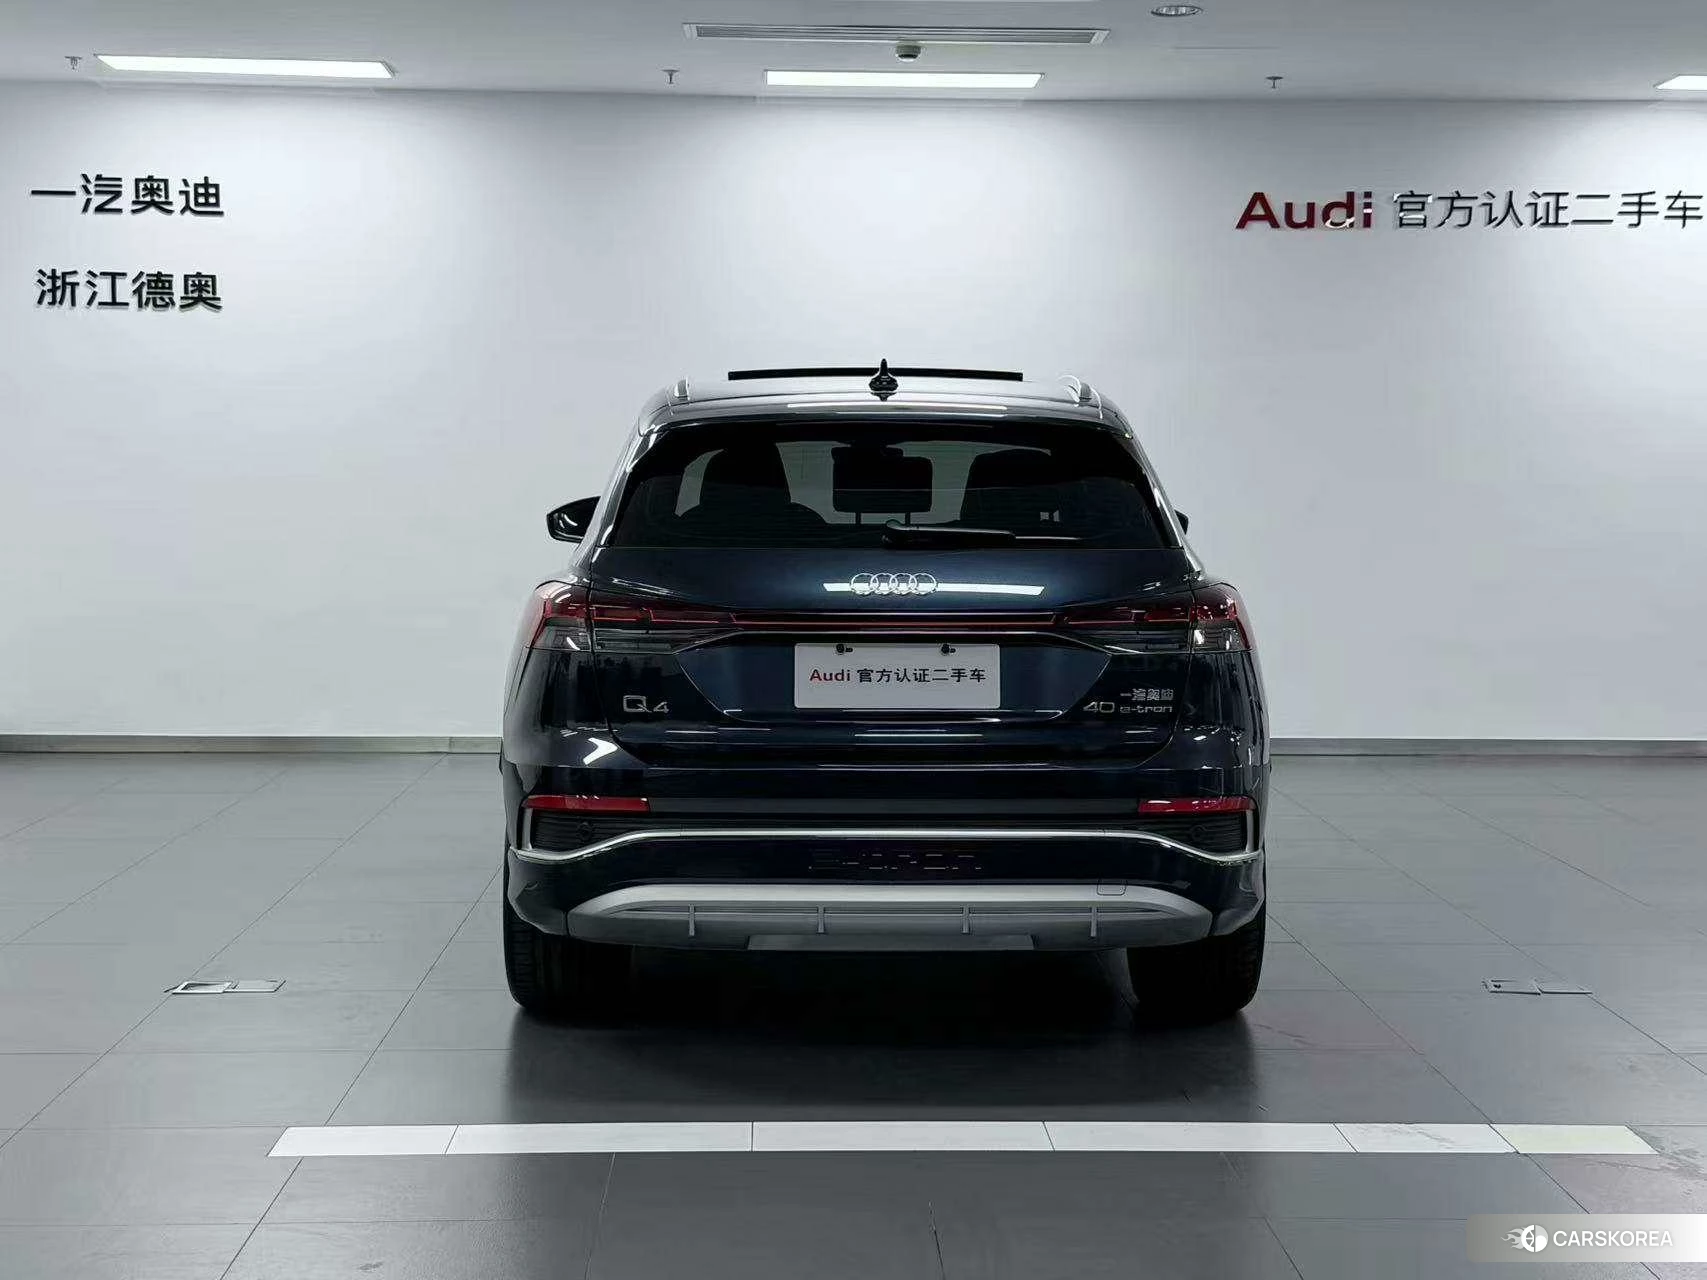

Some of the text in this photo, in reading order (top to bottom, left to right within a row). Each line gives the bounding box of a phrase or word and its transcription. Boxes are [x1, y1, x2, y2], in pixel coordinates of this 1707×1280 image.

[30, 173, 225, 216] 一汽奥迪
[1235, 190, 1704, 229] Audi 官方认证二手车
[36, 268, 223, 310] 浙江德奥
[809, 668, 986, 683] Audi 官方认证二手车
[623, 695, 670, 713] Q4
[1083, 701, 1115, 713] 40
